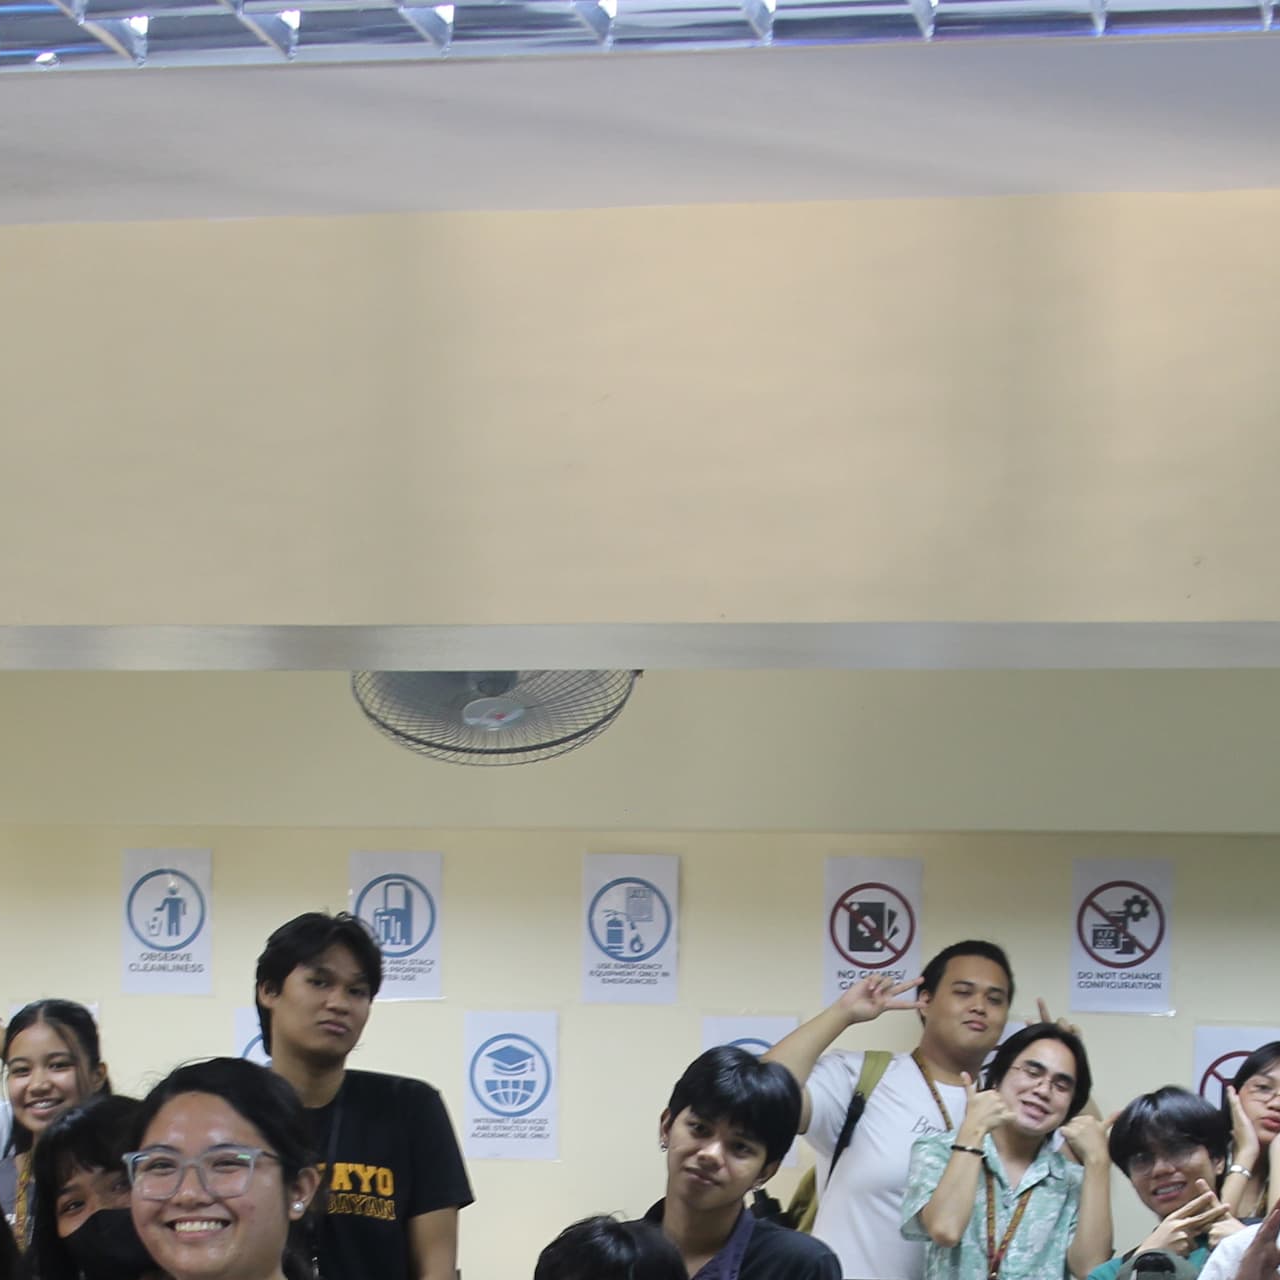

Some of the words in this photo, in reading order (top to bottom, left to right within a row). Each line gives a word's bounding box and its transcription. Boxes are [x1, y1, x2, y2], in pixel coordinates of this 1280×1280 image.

[140, 953, 192, 961] OBSERVE
[128, 963, 205, 973] CLEANLINESS
[837, 970, 856, 979] NO
[1078, 972, 1093, 980] DO
[1097, 972, 1117, 980] NOT
[1120, 972, 1162, 980] CHANGE
[1078, 981, 1162, 989] CONFIGURATION
[316, 1160, 395, 1196] AYO
